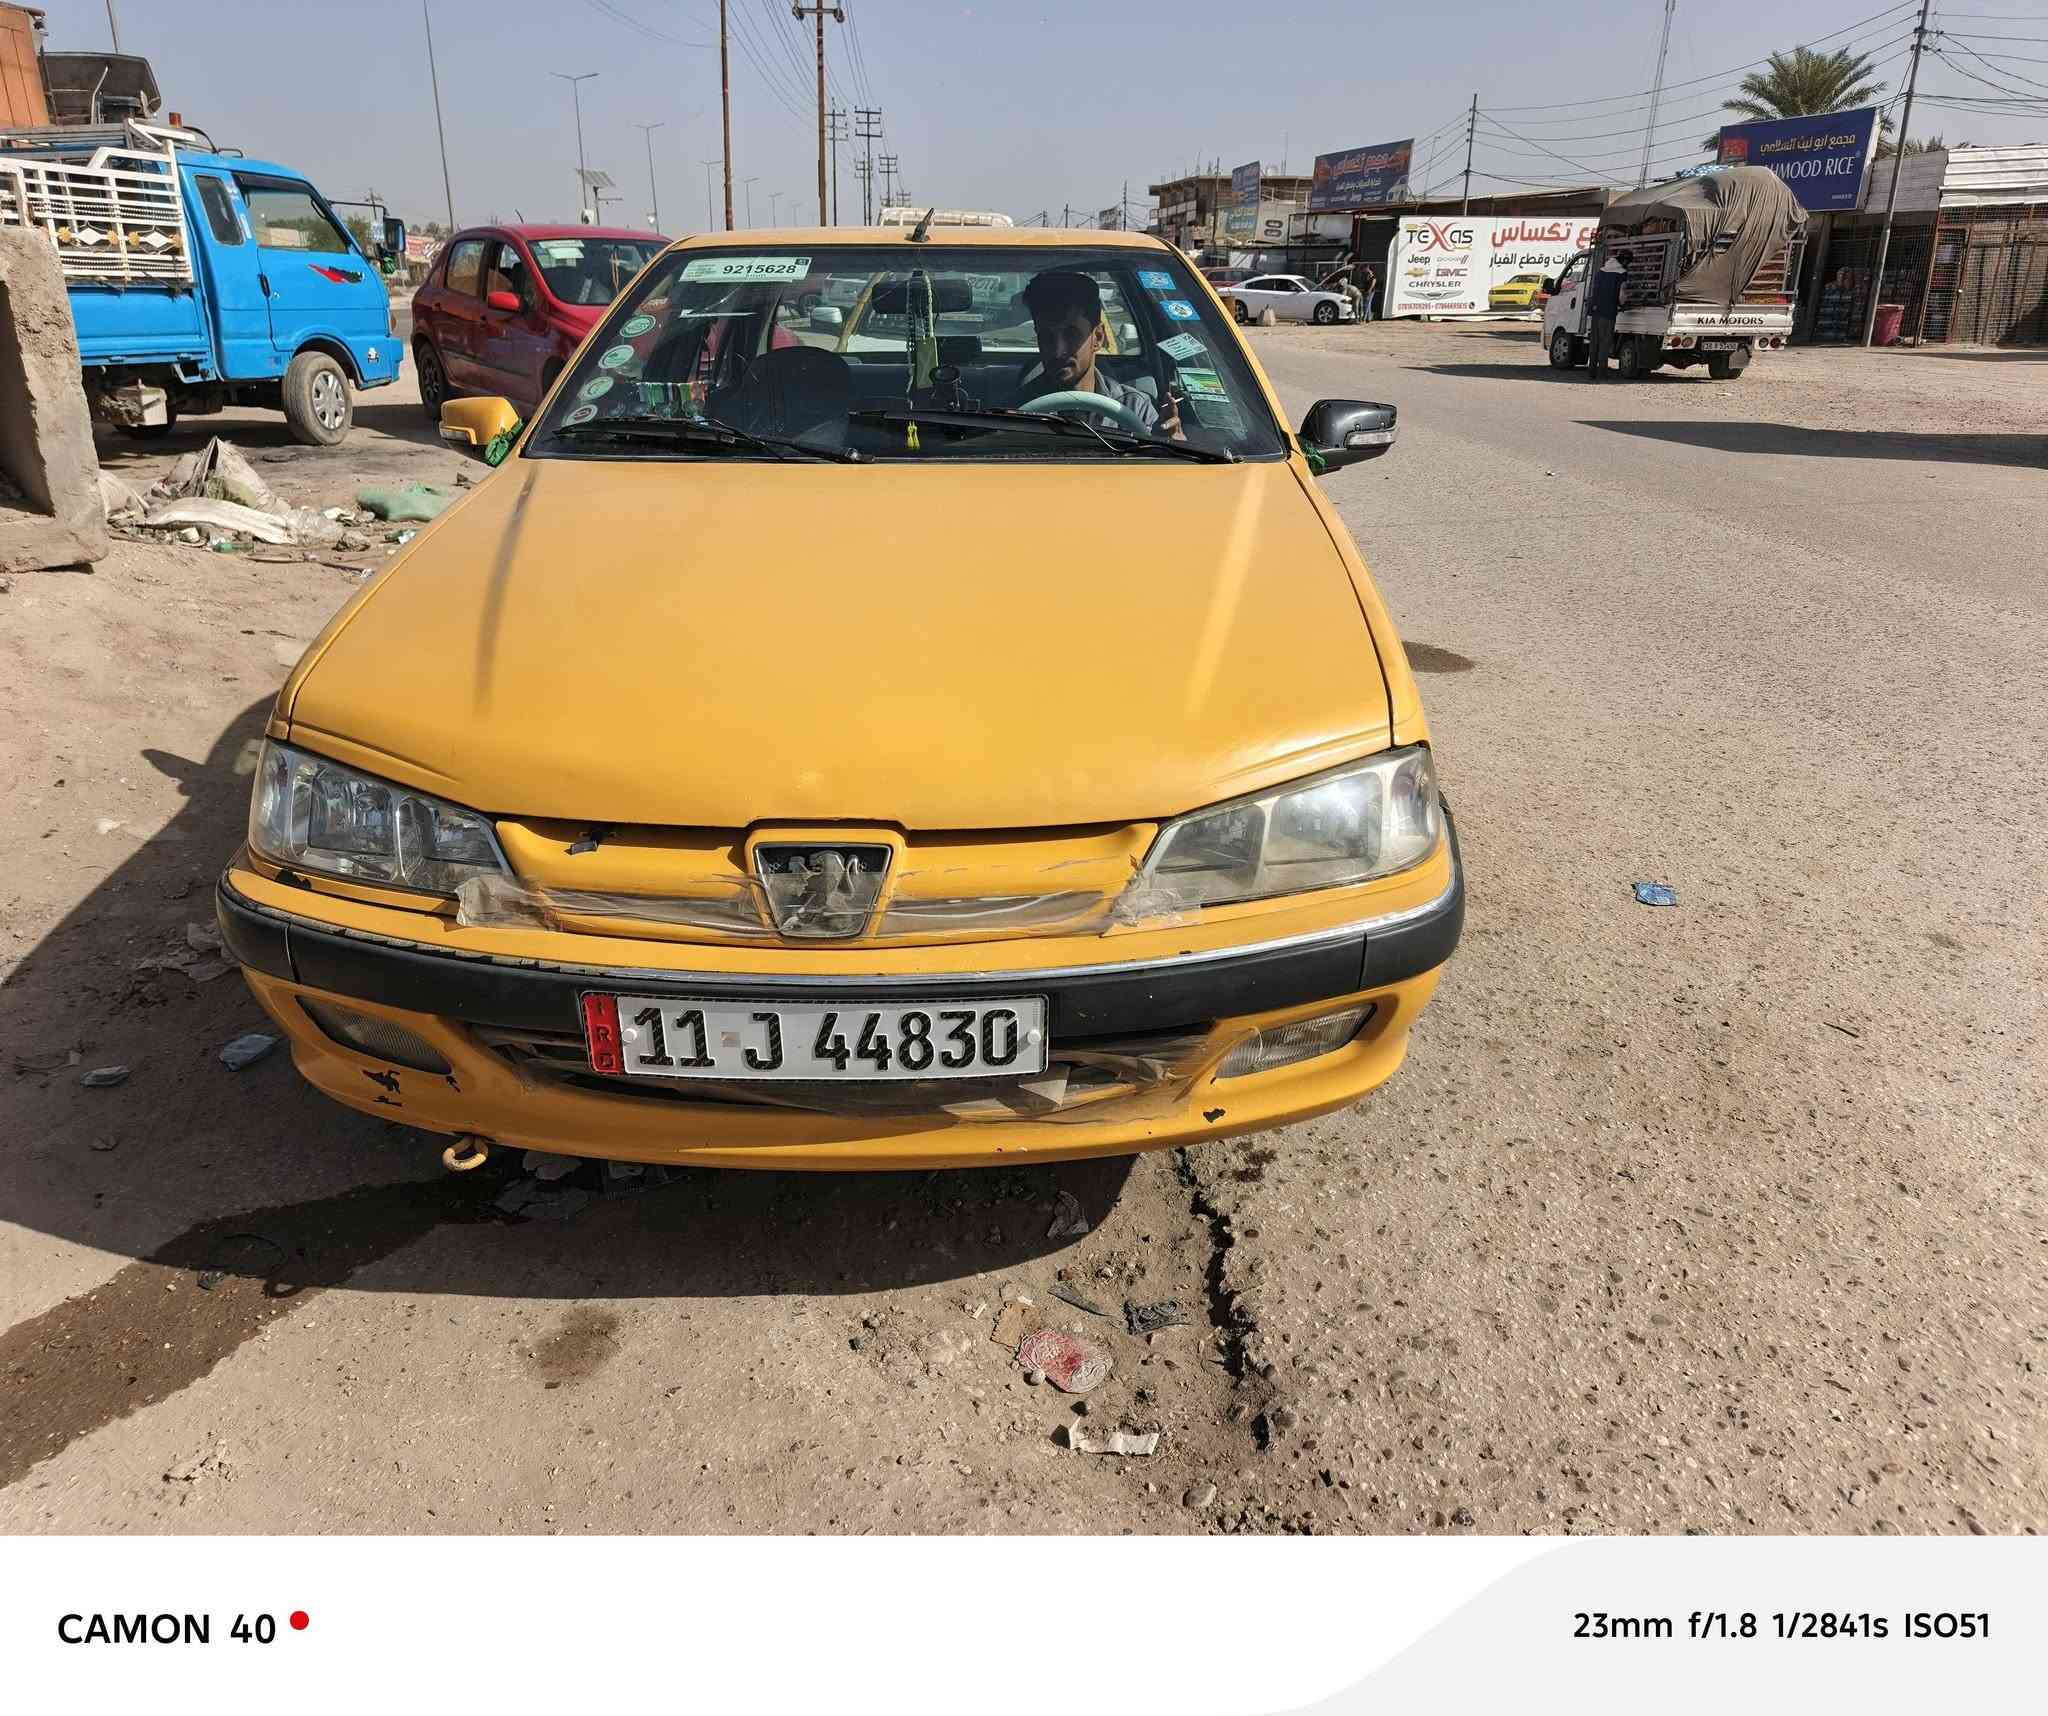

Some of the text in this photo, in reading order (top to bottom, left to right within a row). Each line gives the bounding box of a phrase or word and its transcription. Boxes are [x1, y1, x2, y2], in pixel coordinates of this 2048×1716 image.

[1767, 156, 1857, 179] HMOOD RICE
[1491, 220, 1573, 247] تكساس
[1408, 254, 1431, 265] Jeep
[1489, 253, 1517, 268] الغيار
[1519, 253, 1550, 269] وقطع
[722, 264, 797, 275] 9215628
[1436, 268, 1468, 277] GMC
[1697, 317, 1764, 325] KIA MOTORS
[634, 1007, 1019, 1072] 11 J 44830
